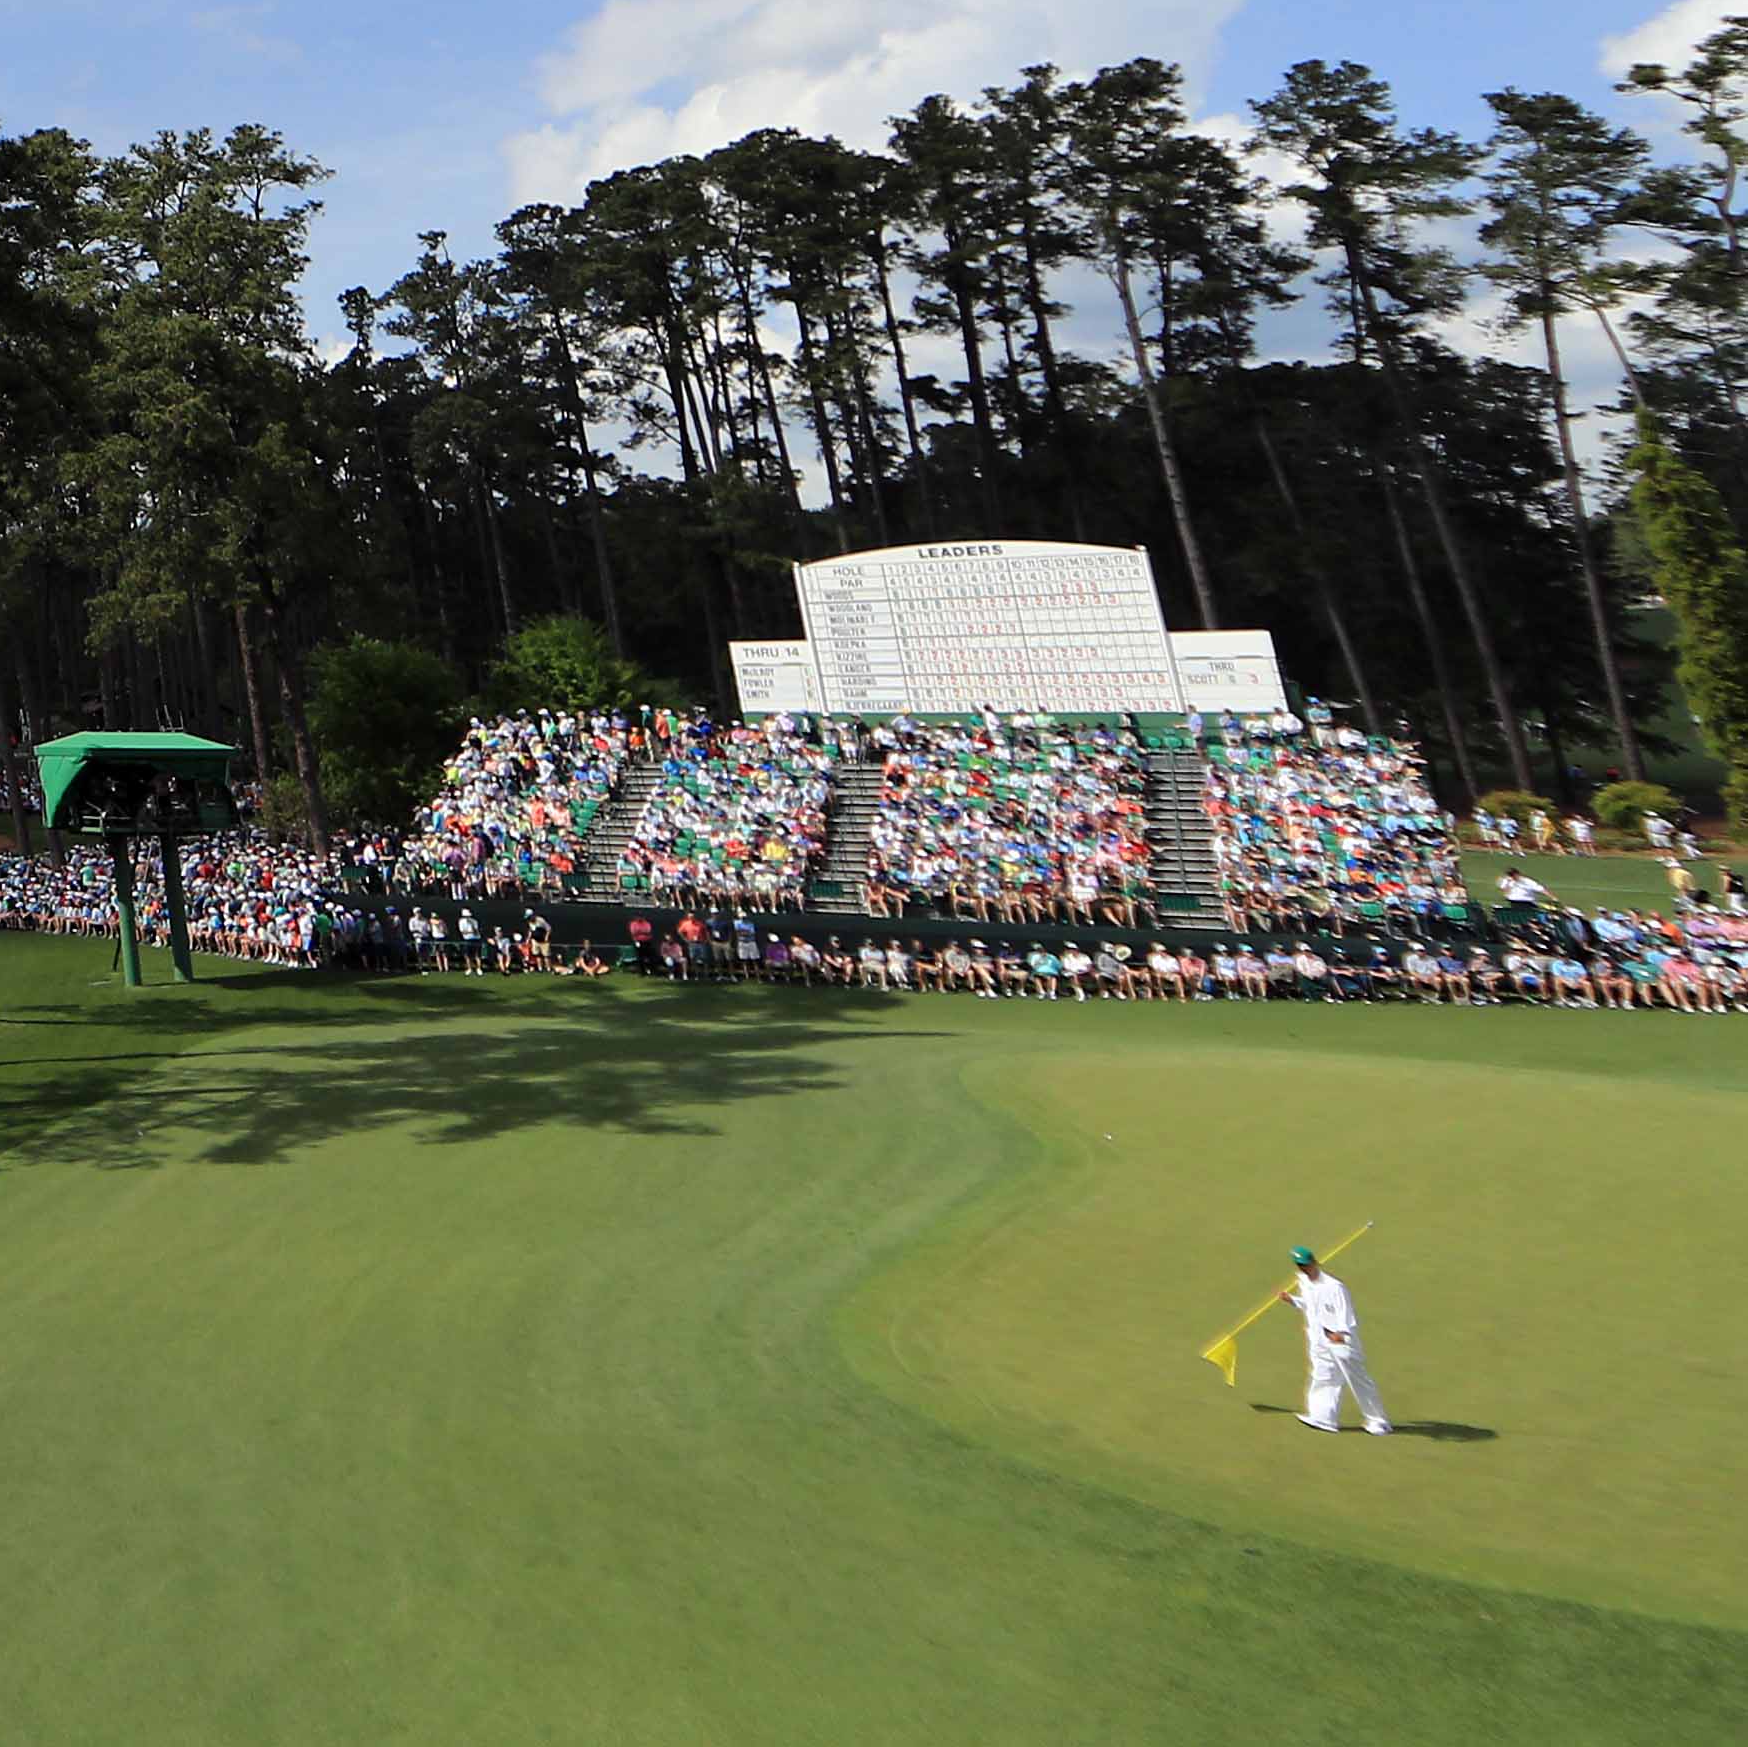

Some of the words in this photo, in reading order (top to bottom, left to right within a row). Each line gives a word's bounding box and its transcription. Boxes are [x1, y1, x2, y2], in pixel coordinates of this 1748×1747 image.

[918, 545, 1003, 558] LEADERS
[833, 568, 864, 577] HOLE
[887, 563, 893, 573] 1
[901, 564, 909, 574] 2
[927, 562, 935, 572] 4
[969, 560, 977, 570] 7
[1009, 558, 1022, 569] 10
[1025, 558, 1036, 569] 11
[1038, 558, 1051, 568] 12
[1053, 557, 1066, 568] 13
[1067, 557, 1081, 567] 14
[1082, 556, 1095, 567] 15
[1113, 555, 1124, 566] 17
[840, 579, 864, 588] PAR
[916, 573, 924, 584] 4
[943, 572, 951, 583] 4
[970, 571, 978, 582] 4
[999, 570, 1007, 581] 4
[1014, 570, 1022, 580] 4
[1029, 569, 1037, 580] 4
[1133, 568, 1141, 578] 4
[743, 647, 779, 658] THRU
[784, 647, 799, 657] 14
[1188, 675, 1219, 684] SCOTT
